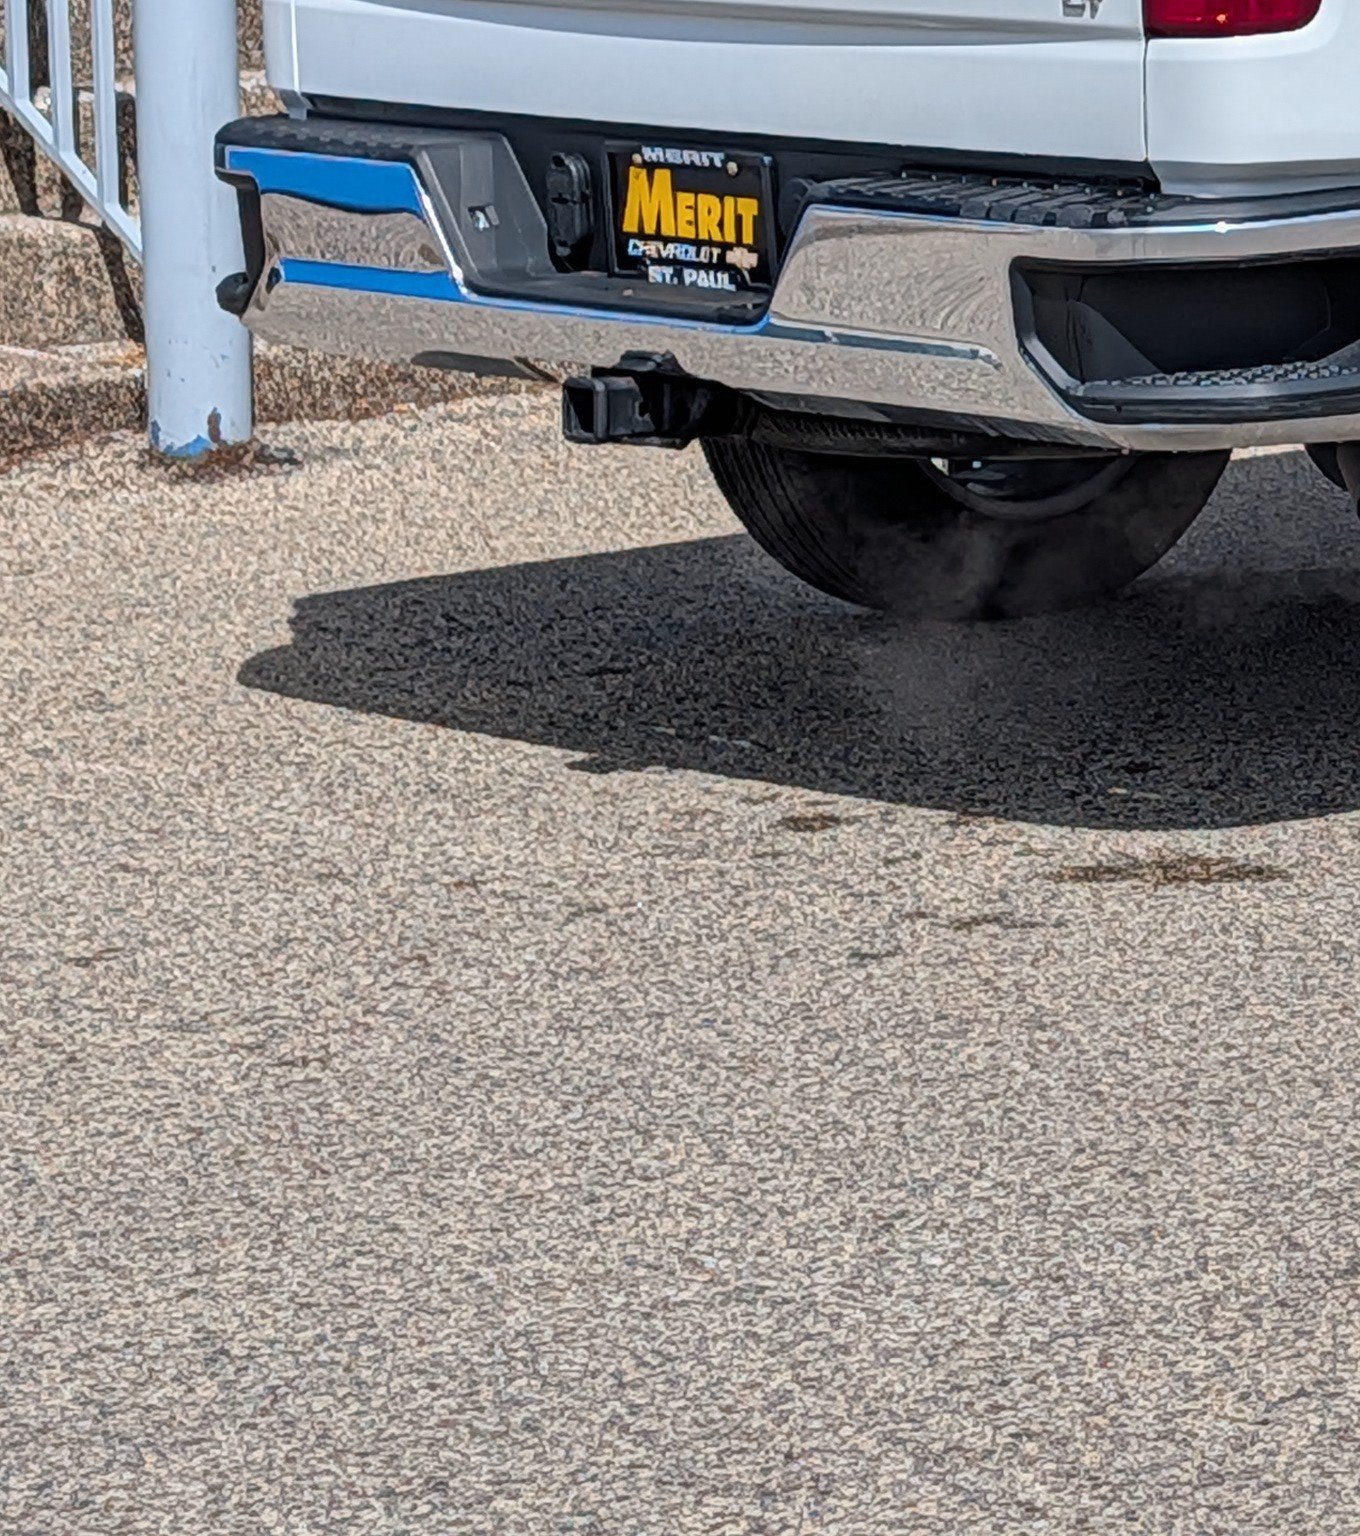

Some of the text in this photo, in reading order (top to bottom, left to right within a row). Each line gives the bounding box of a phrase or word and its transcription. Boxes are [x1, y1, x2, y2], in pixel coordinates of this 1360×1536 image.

[640, 145, 726, 168] MERIT
[622, 167, 758, 244] MERIT
[627, 238, 721, 263] CHEVROLET
[648, 265, 736, 292] ST. PAUL
